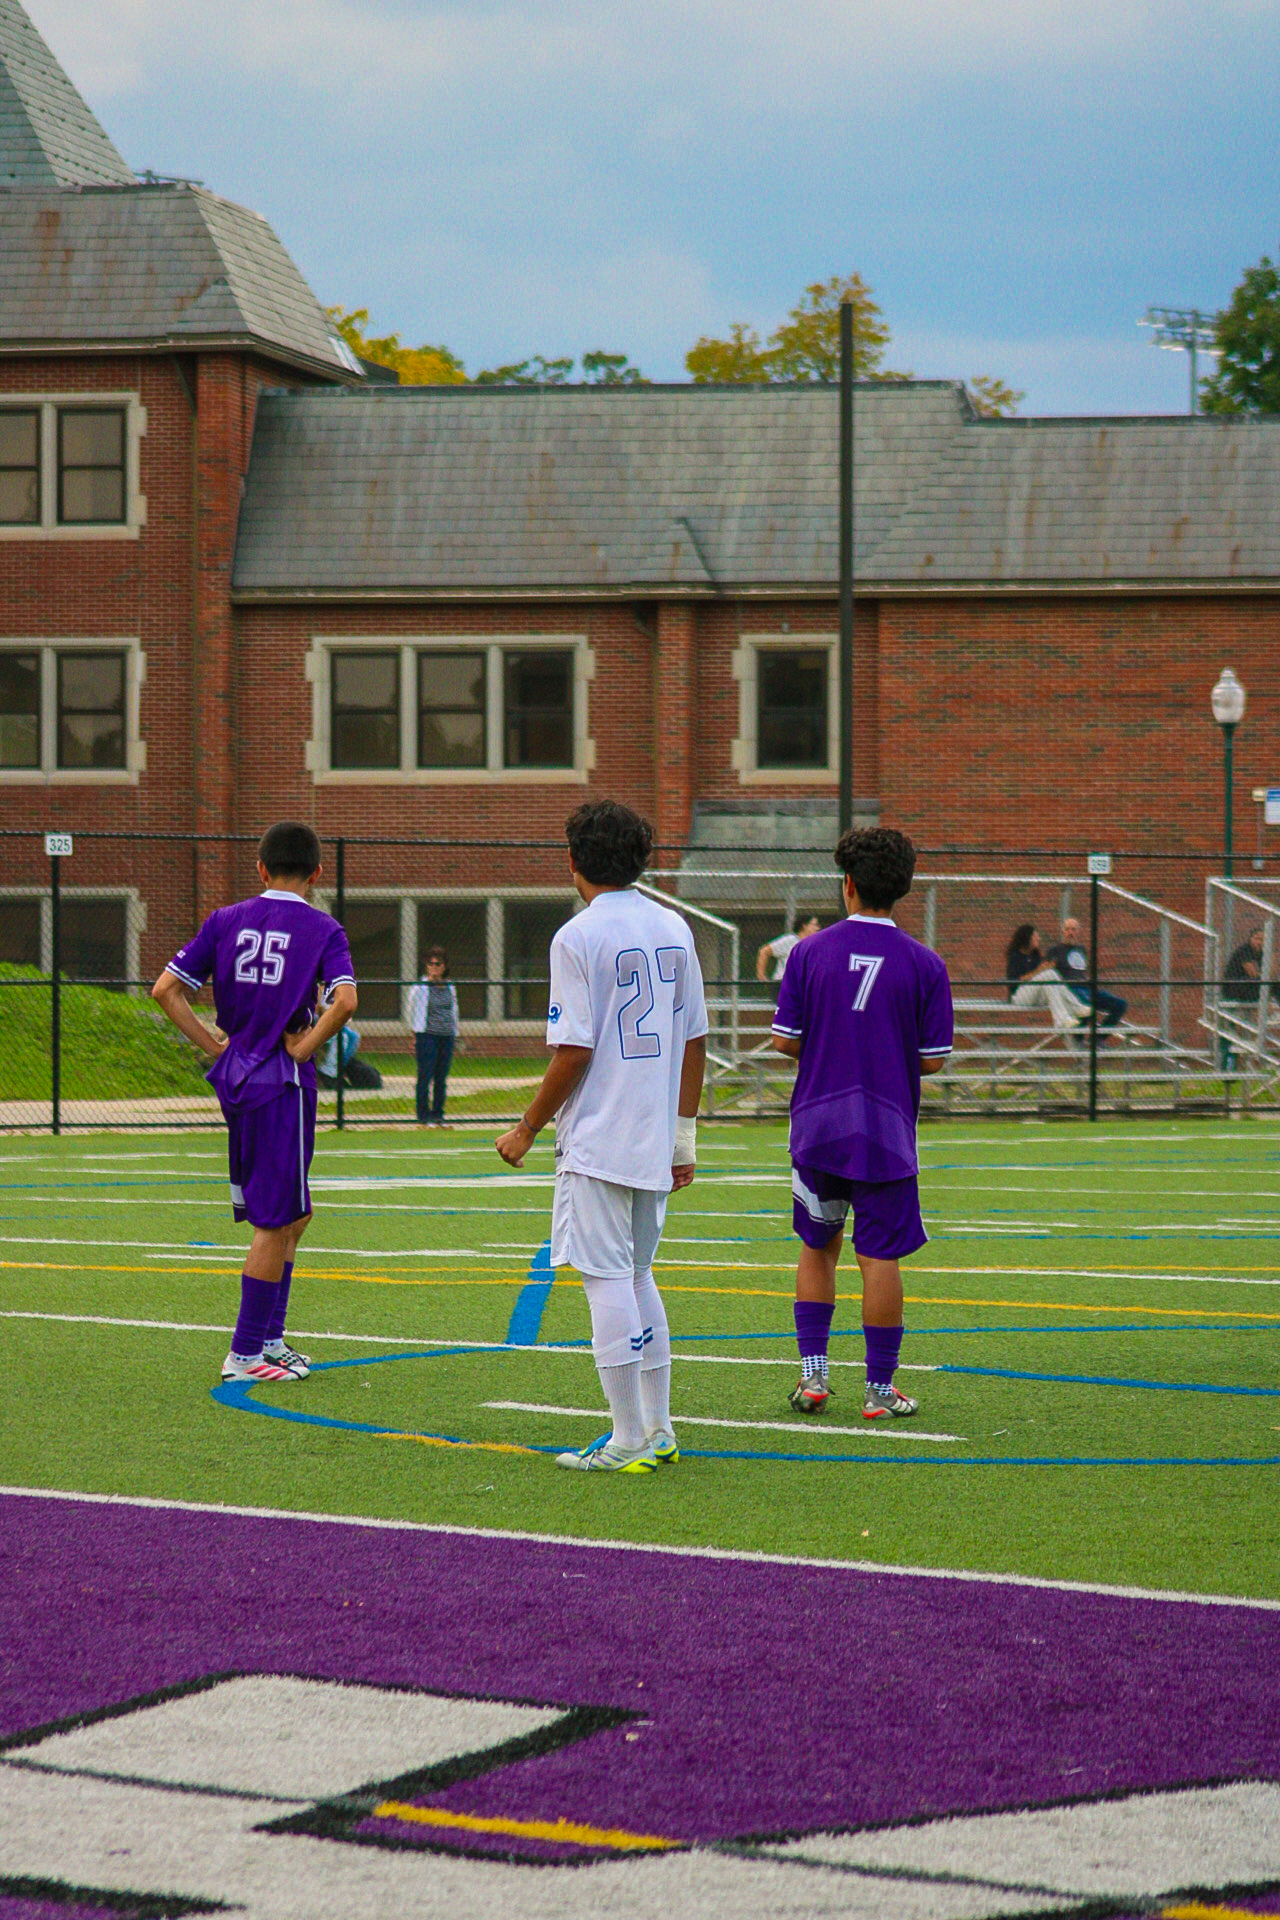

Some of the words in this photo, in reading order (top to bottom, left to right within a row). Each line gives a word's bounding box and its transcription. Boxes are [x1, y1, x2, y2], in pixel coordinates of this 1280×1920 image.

[49, 838, 70, 852] 325
[235, 928, 291, 986] 25
[848, 952, 885, 1012] 7
[616, 946, 687, 1060] 27
